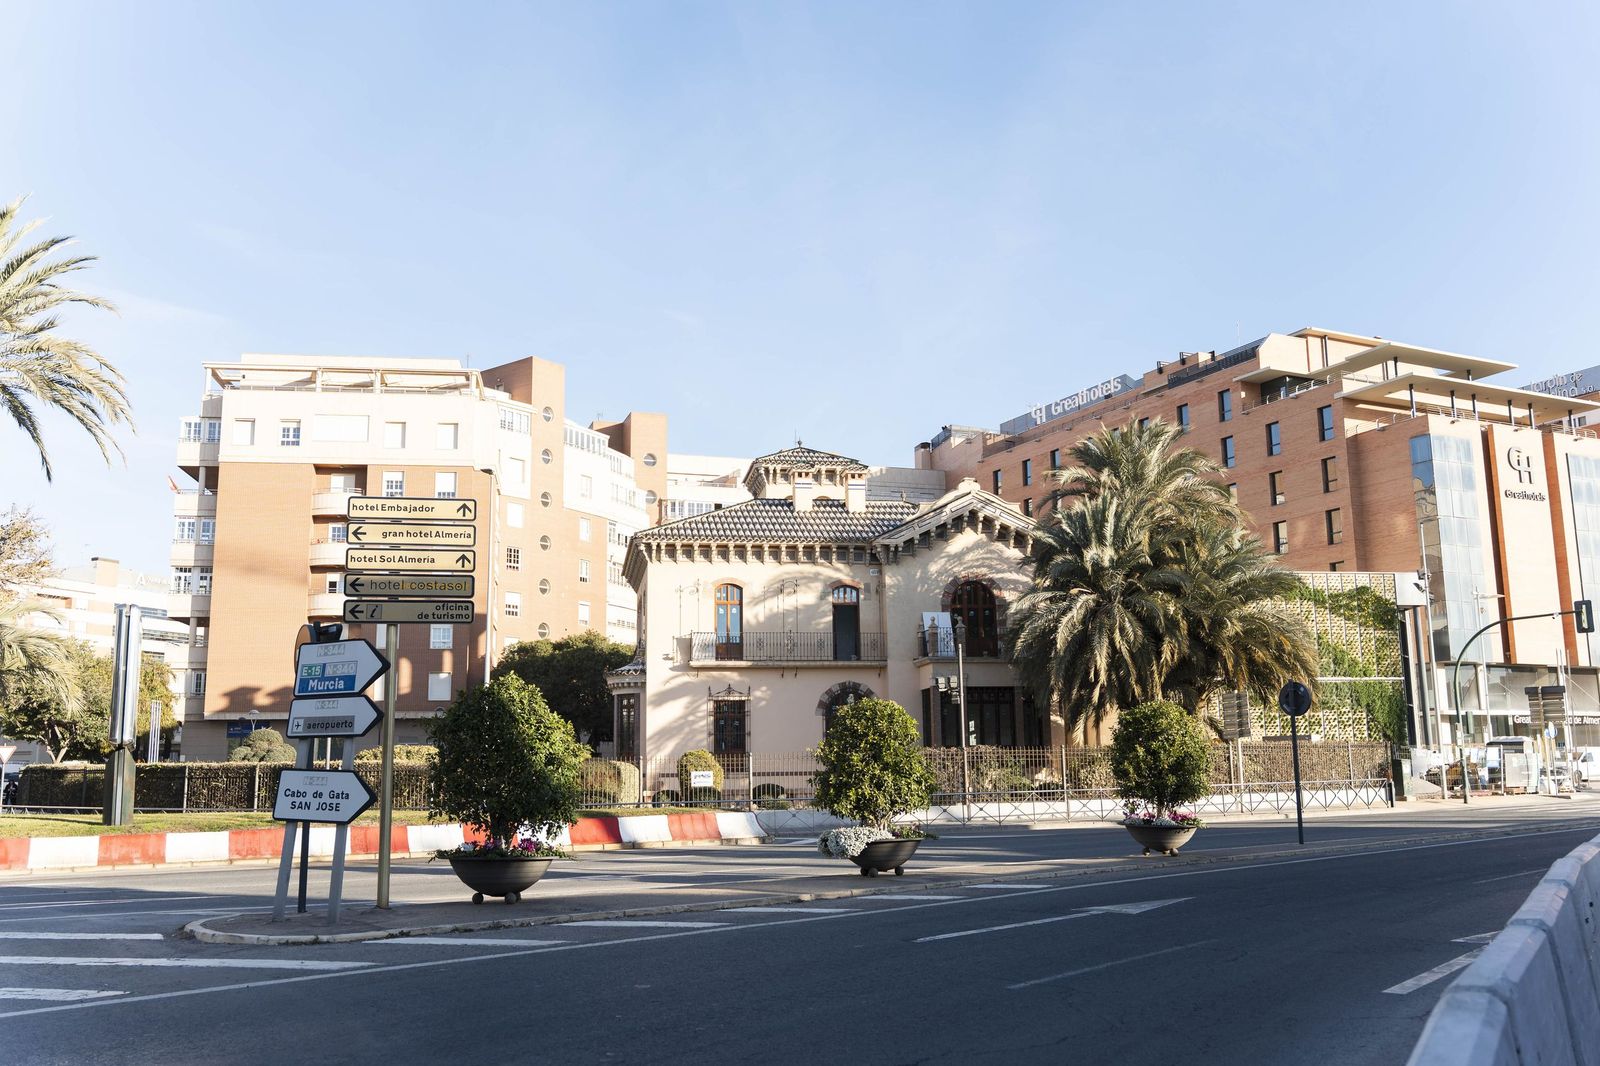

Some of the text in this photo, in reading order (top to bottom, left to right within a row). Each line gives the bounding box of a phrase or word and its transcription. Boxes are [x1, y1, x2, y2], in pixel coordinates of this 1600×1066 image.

[1051, 377, 1122, 415] Greathotels
[1504, 489, 1546, 502] Greathotels
[352, 504, 435, 513] hotel Embajador
[406, 530, 432, 538] hotel
[434, 530, 472, 539] Almería
[370, 580, 467, 591] hotel costasol
[432, 612, 470, 620] turismo
[318, 644, 344, 656] N-344
[302, 663, 355, 676] E-15 N-340
[308, 678, 344, 690] Murcia
[307, 720, 353, 730] aeropuerto
[284, 788, 350, 800] Cabo de Gata
[290, 801, 341, 812] SAN JOSE
